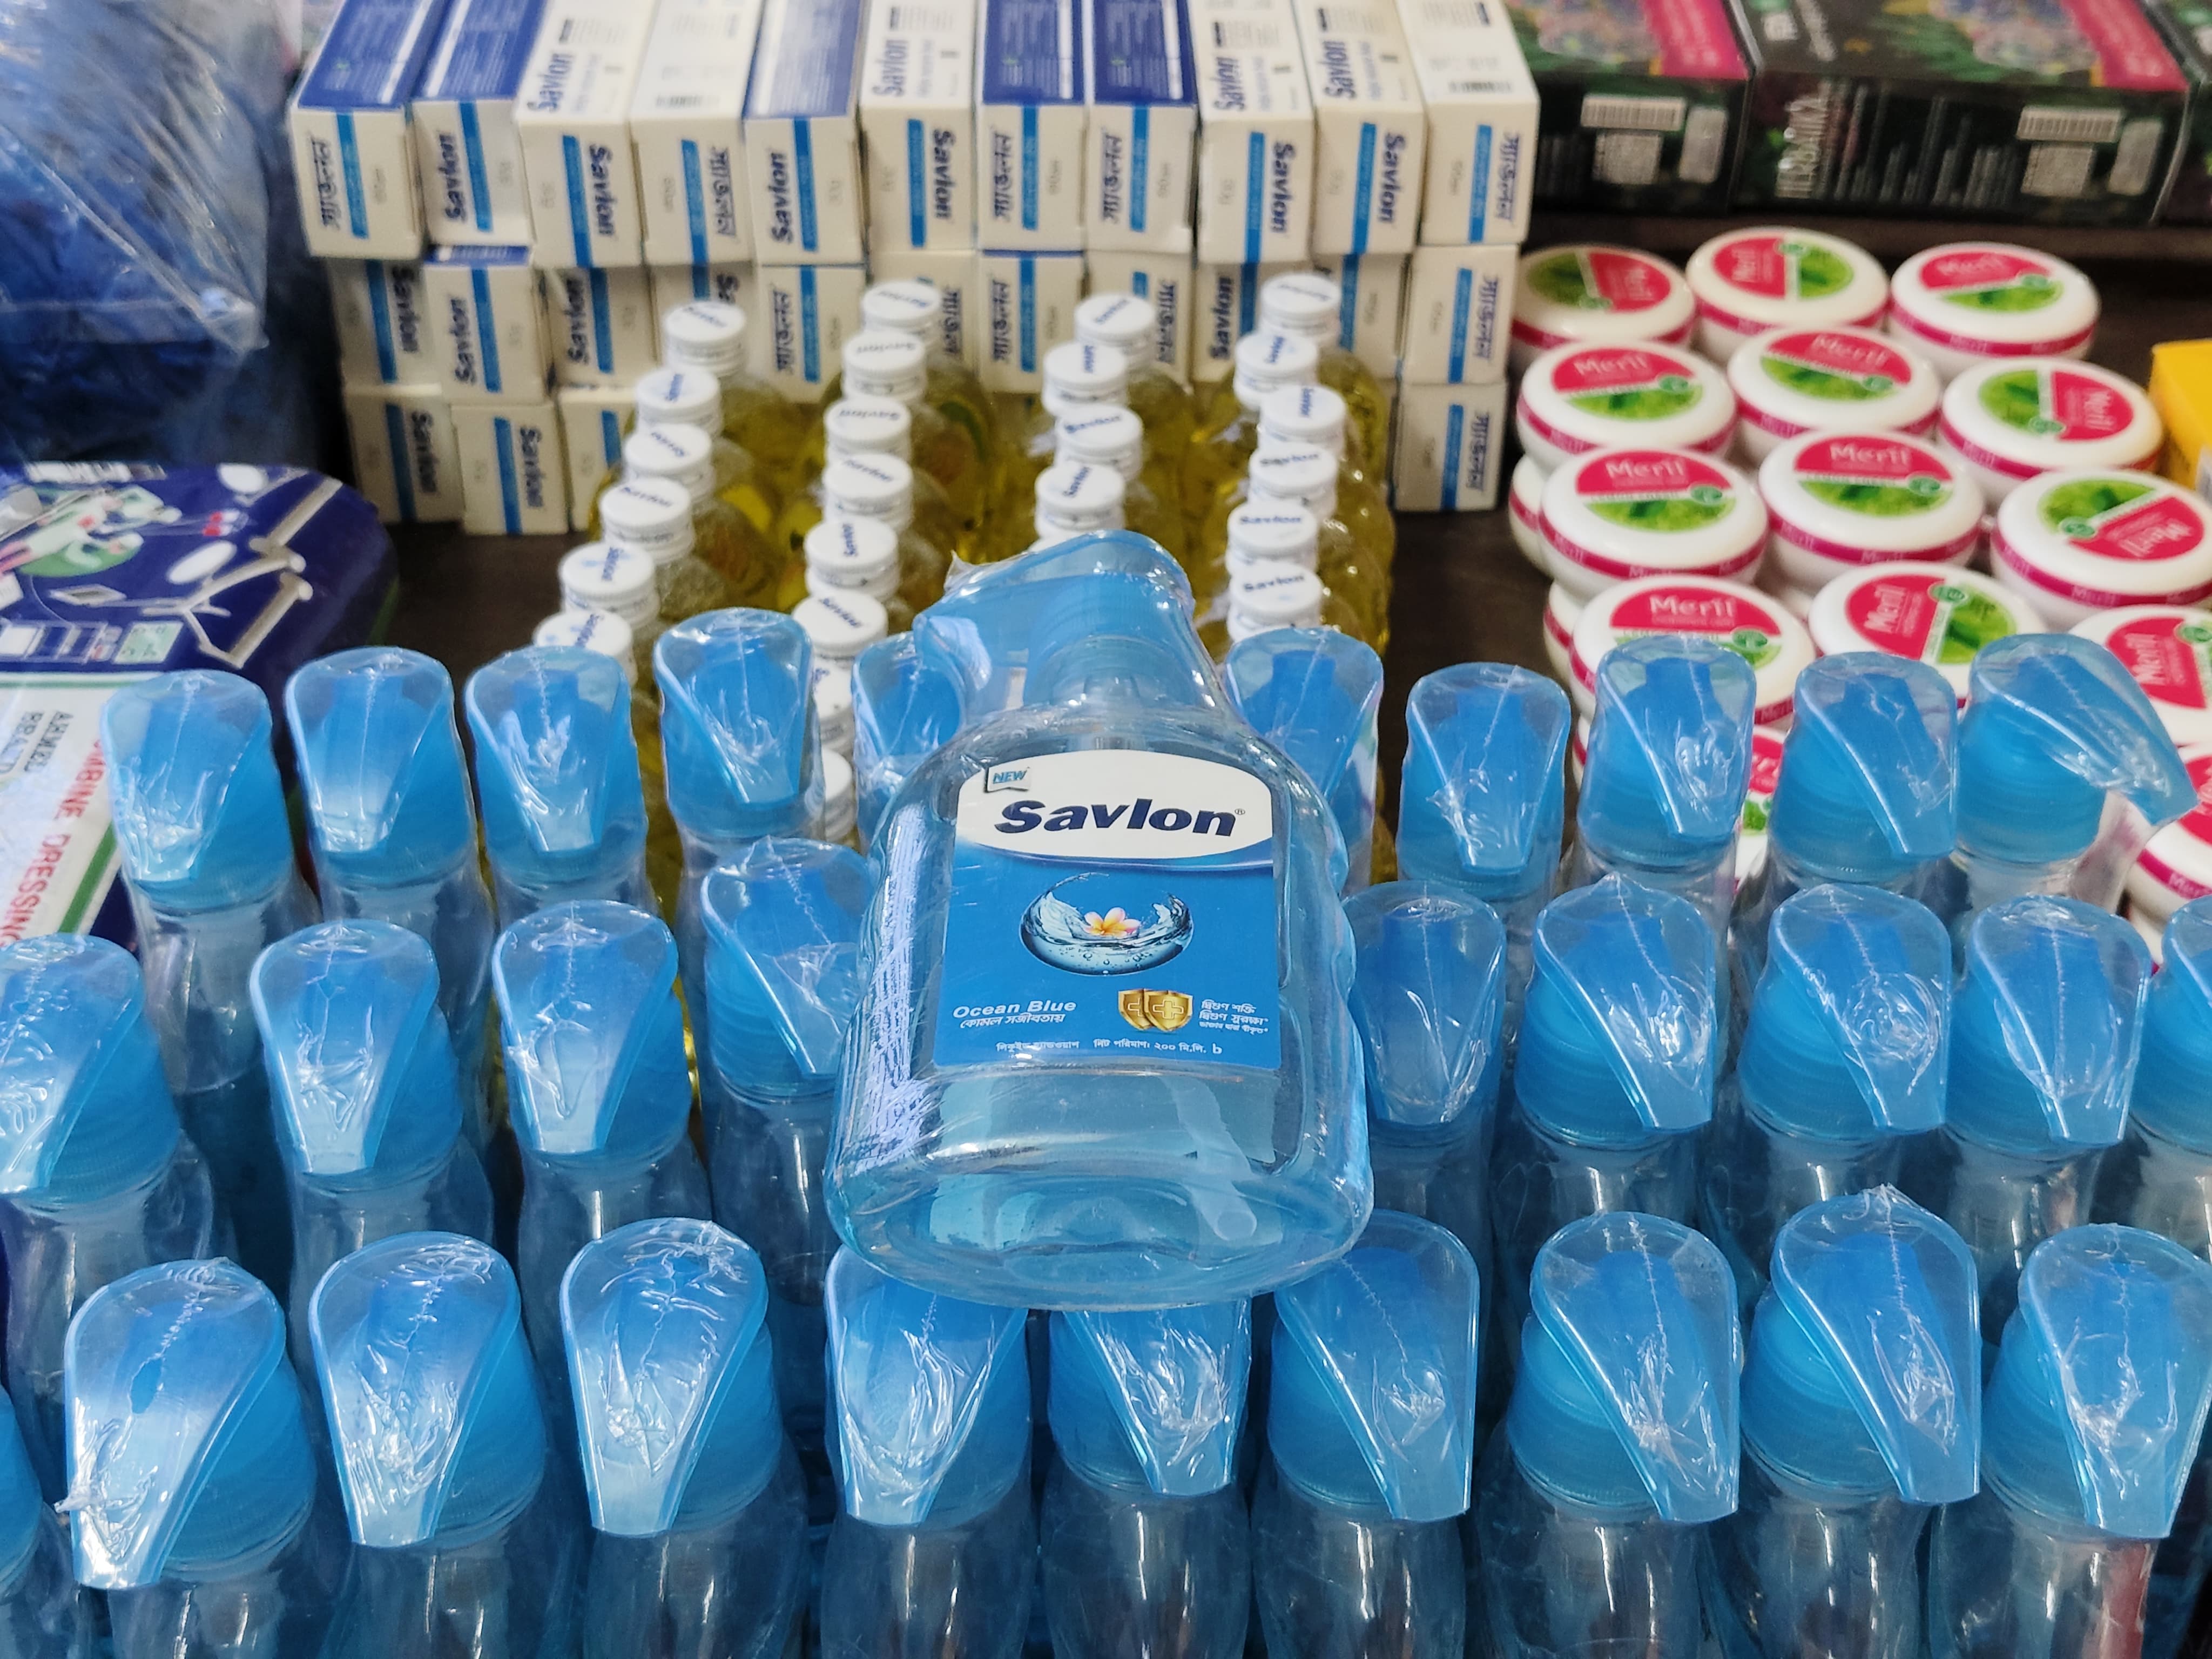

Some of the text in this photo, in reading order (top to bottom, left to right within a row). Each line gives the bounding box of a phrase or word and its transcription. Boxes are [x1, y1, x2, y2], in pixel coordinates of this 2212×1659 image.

[1319, 40, 1355, 99] Savlon
[589, 144, 615, 238] Savlon
[769, 152, 793, 243] Savlon
[933, 129, 956, 220] Savlon
[1270, 140, 1294, 235] Savlon
[1377, 131, 1406, 225] Savlon
[1210, 276, 1233, 360] Savlon
[1605, 458, 1685, 478] Meril
[1650, 595, 1735, 616] Meril
[993, 770, 1027, 784] NEW
[953, 1000, 1077, 1018] Ocean Blue
[960, 1016, 1003, 1029] কোমল
[1154, 1042, 1176, 1050] ২০০
